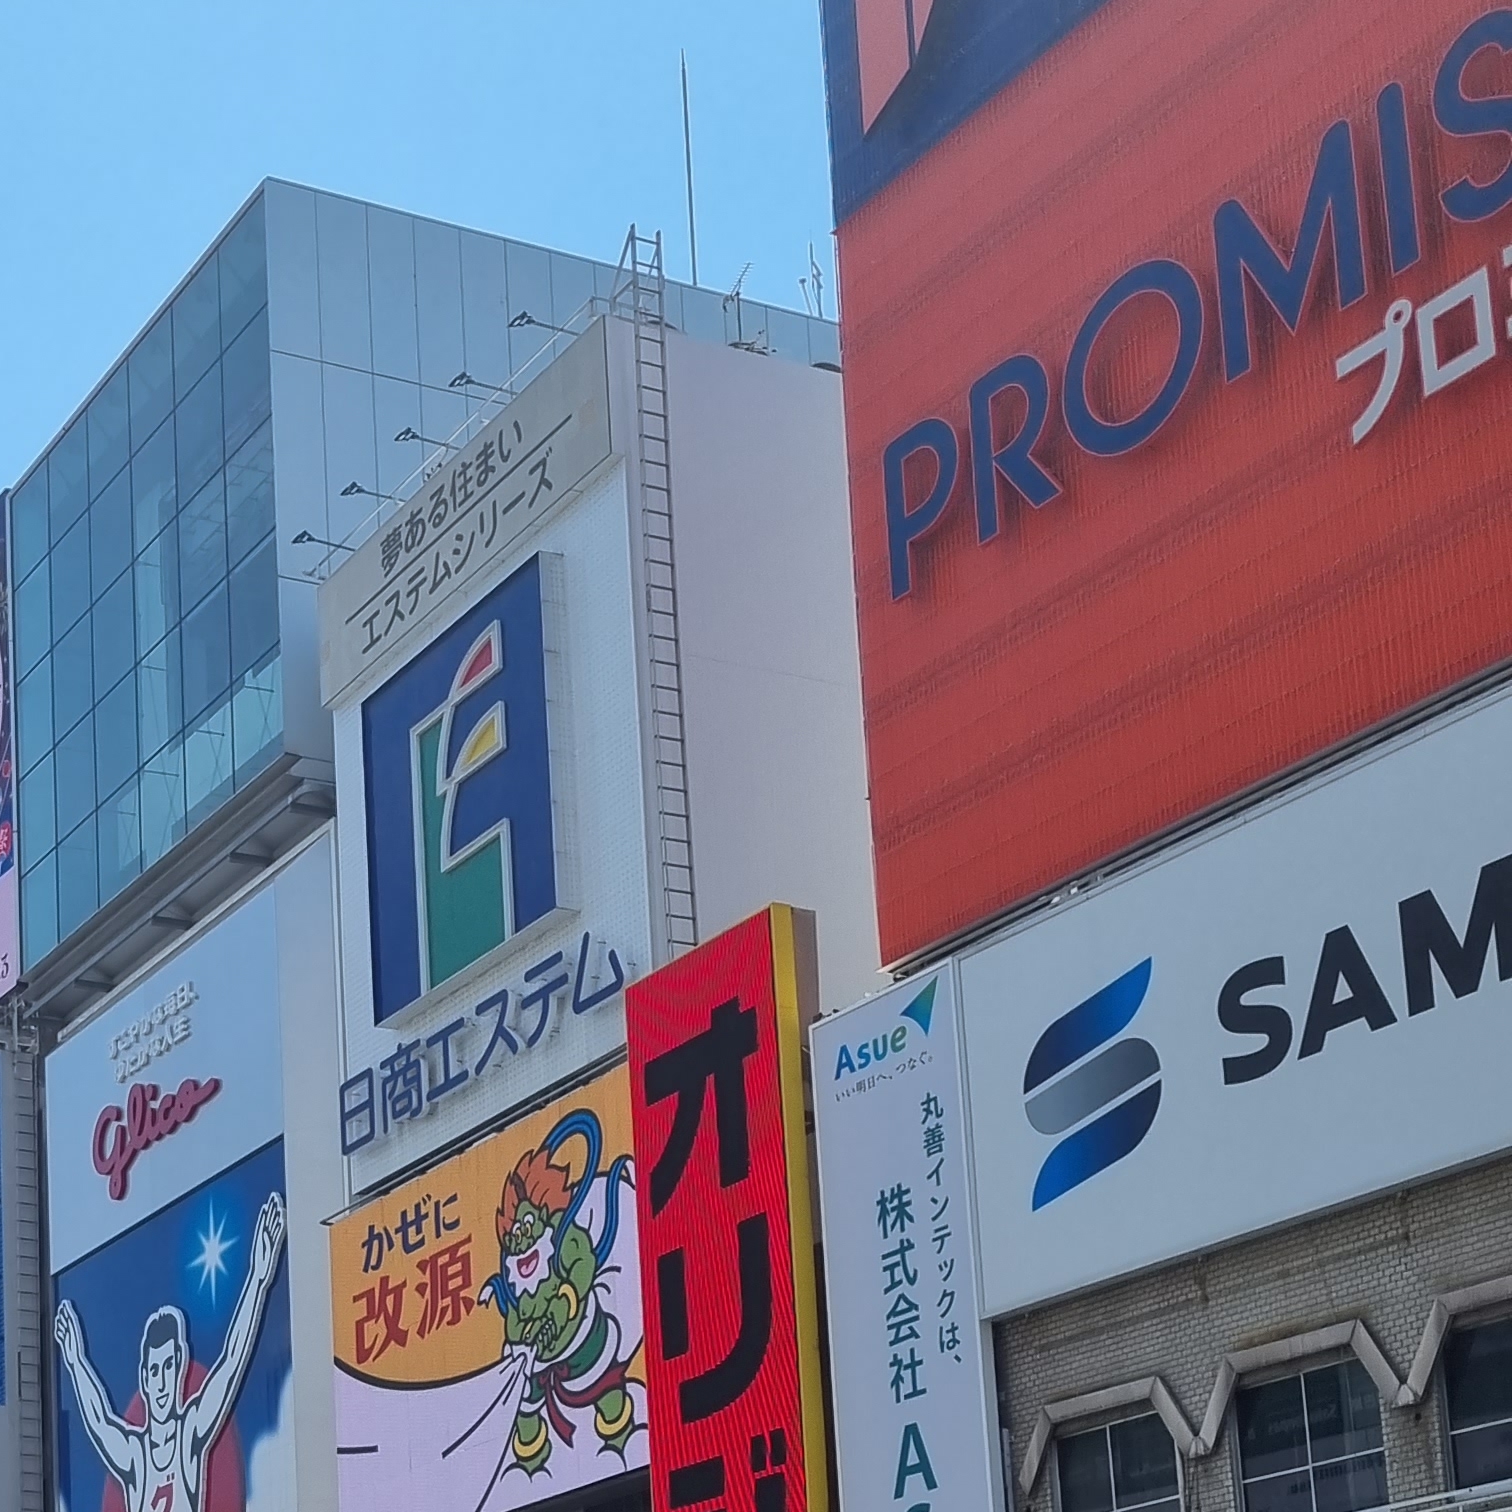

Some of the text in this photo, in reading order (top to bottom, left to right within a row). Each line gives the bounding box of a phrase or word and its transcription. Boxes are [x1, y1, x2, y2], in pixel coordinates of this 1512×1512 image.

[1335, 245, 1512, 445] プロ
[362, 447, 553, 654] エステムシリーズ
[380, 420, 522, 571] 夢ある住まい
[339, 931, 625, 1156] 日商エステム
[834, 1022, 909, 1081] Asue
[834, 1054, 934, 1103] いい明日へ、つなぐ。
[93, 1077, 223, 1200] Glico
[352, 1233, 477, 1365] 改源
[361, 1192, 461, 1273] かぜに
[876, 1183, 927, 1404] 株式会社
[920, 1092, 963, 1367] 丸善インテックは、
